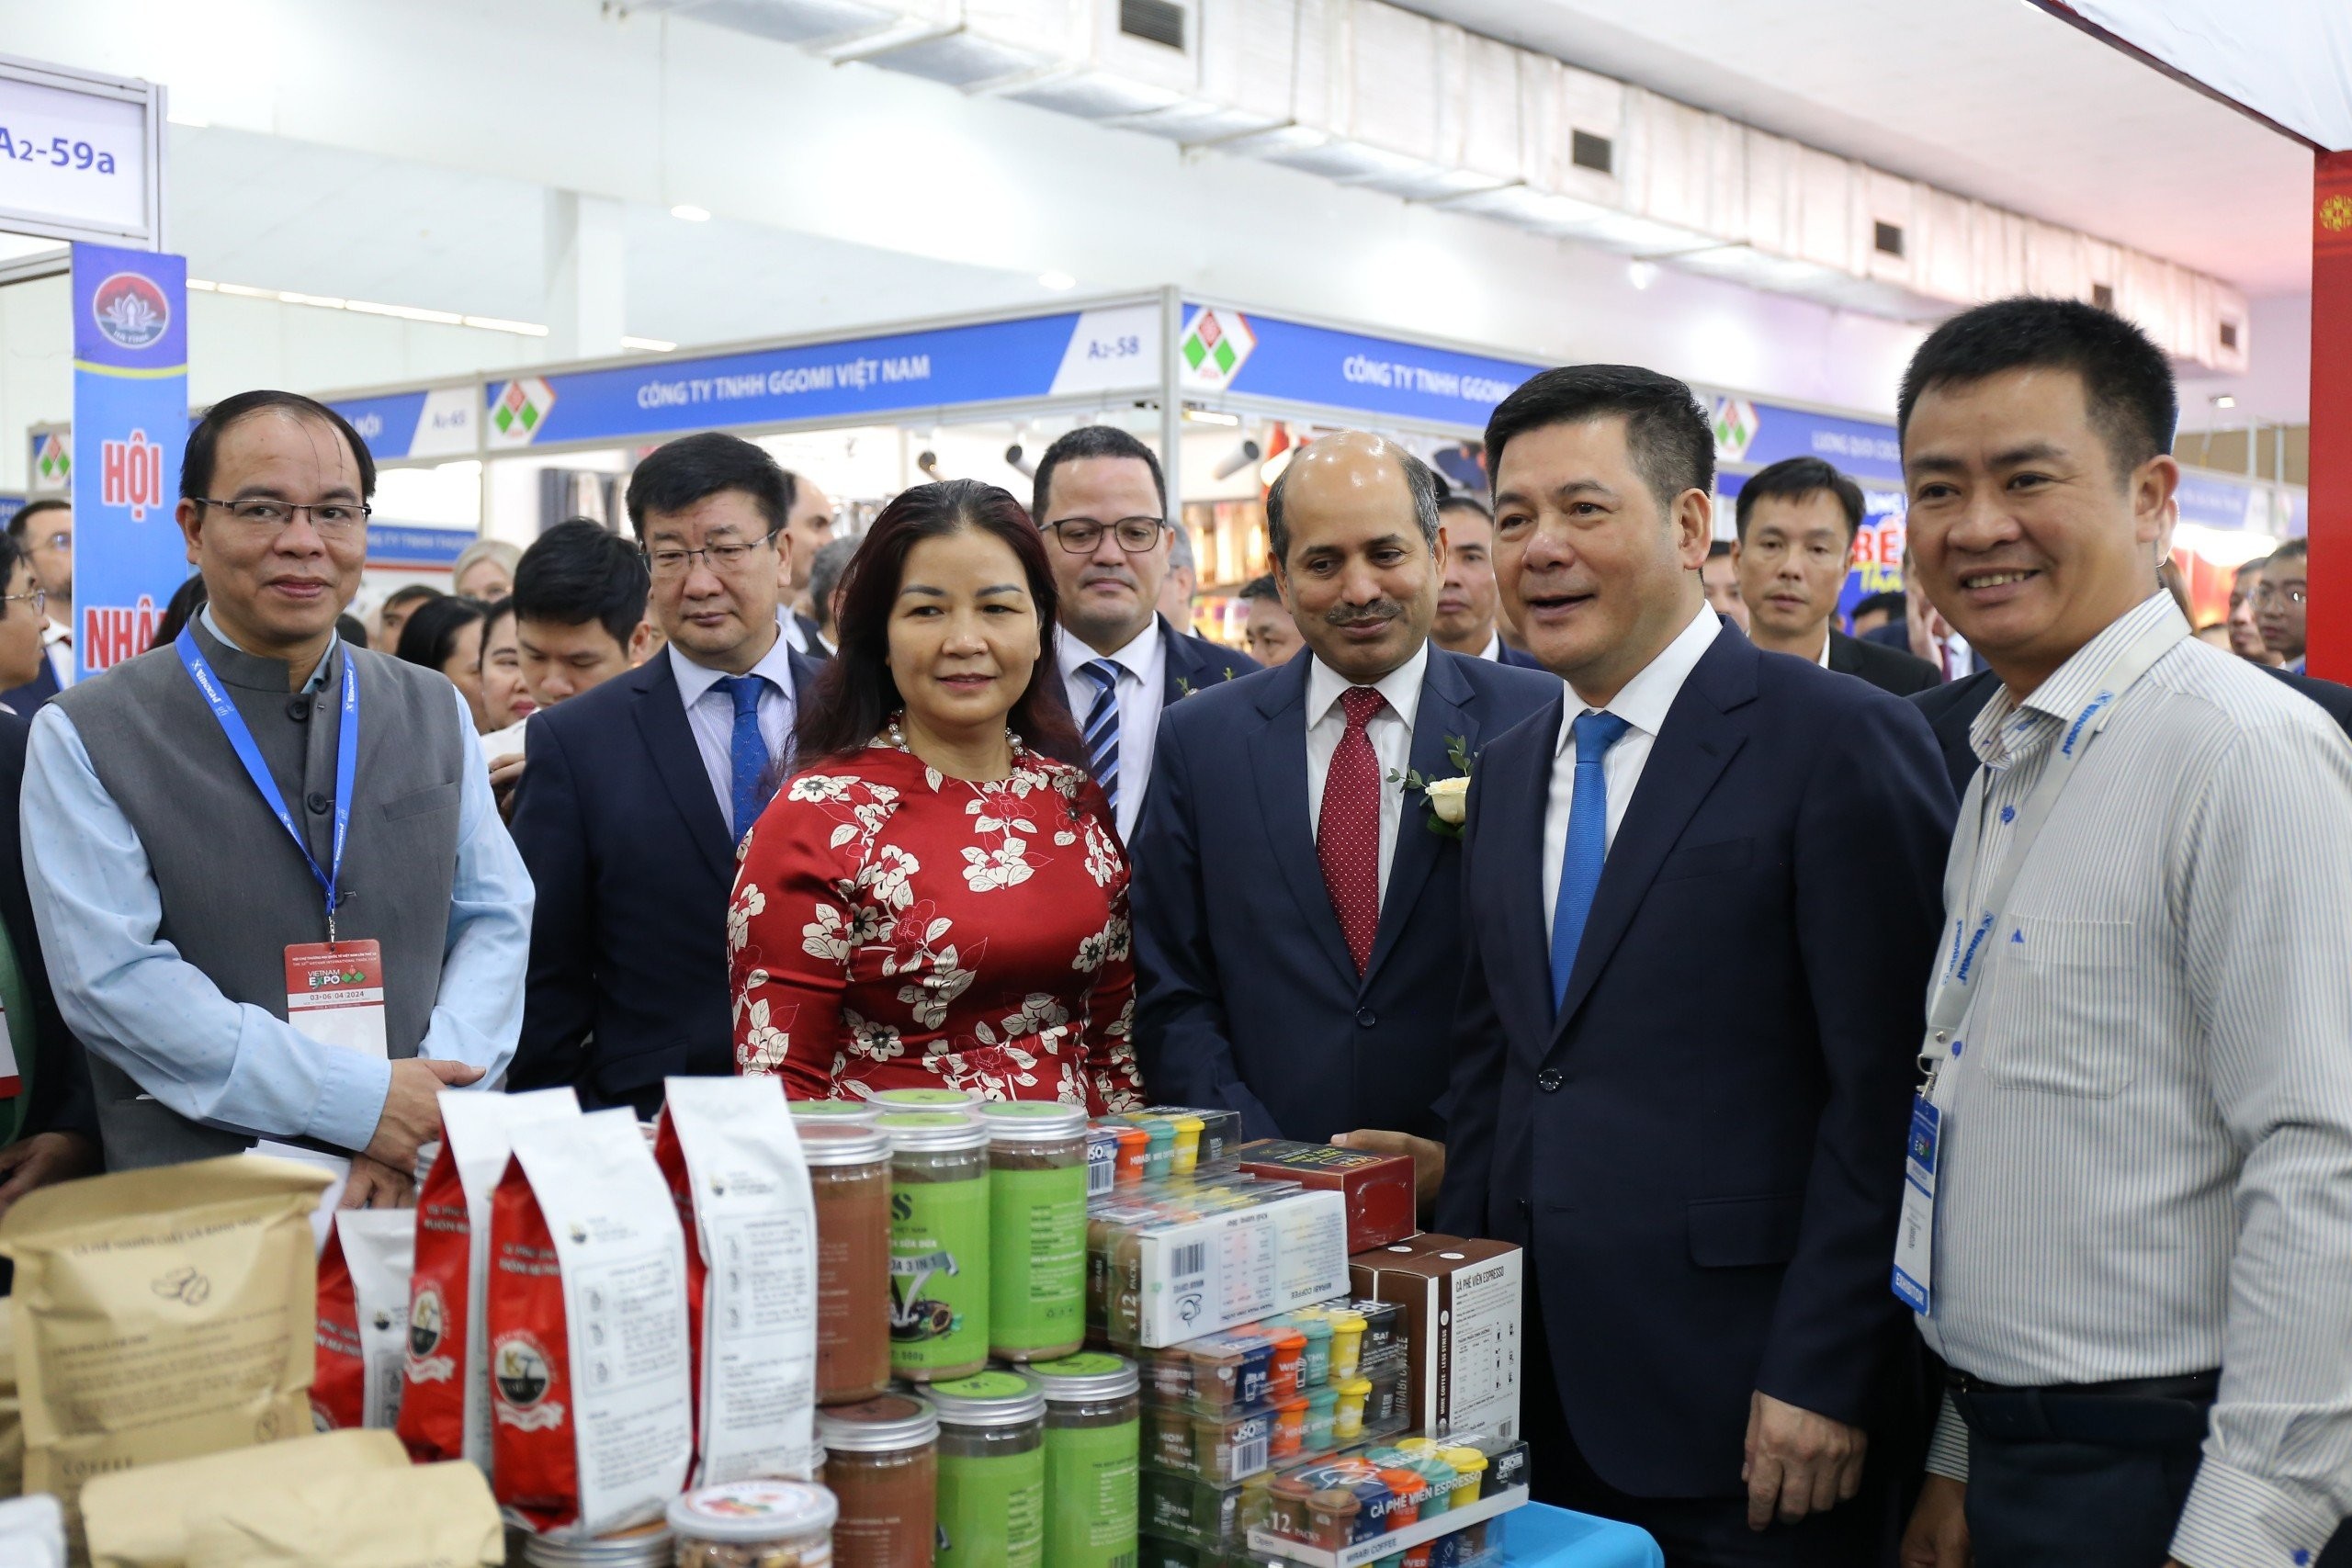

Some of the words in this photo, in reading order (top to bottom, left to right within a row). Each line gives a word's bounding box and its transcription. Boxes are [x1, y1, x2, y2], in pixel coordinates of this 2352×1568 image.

[637, 379, 688, 409] CÔNG
[690, 378, 712, 403] TY
[715, 372, 766, 401] TNHH
[768, 365, 834, 395] GGOMI
[835, 356, 879, 391] VIỆT
[882, 354, 931, 383] NAM
[1342, 354, 1393, 388] CÔNG
[1393, 364, 1413, 390] TY
[1416, 367, 1460, 398] TNHH
[103, 430, 161, 520] HỘI
[85, 596, 167, 671] NHÂ
[307, 969, 340, 977] VIETNAM
[309, 976, 340, 988] EXPO
[1483, 1266, 1505, 1283] ESPRESSO
[1122, 1293, 1137, 1318] 12
[1373, 1331, 1389, 1341] SAT
[1370, 1500, 1385, 1518] CÀ
[1385, 1493, 1408, 1515] PHÊ
[1408, 1485, 1433, 1505] VIÊN
[1434, 1470, 1483, 1497] ESPRESSO
[1271, 1511, 1291, 1534] 12
[1346, 1549, 1370, 1562] MIRABI
[1370, 1538, 1397, 1555] COFFEE
